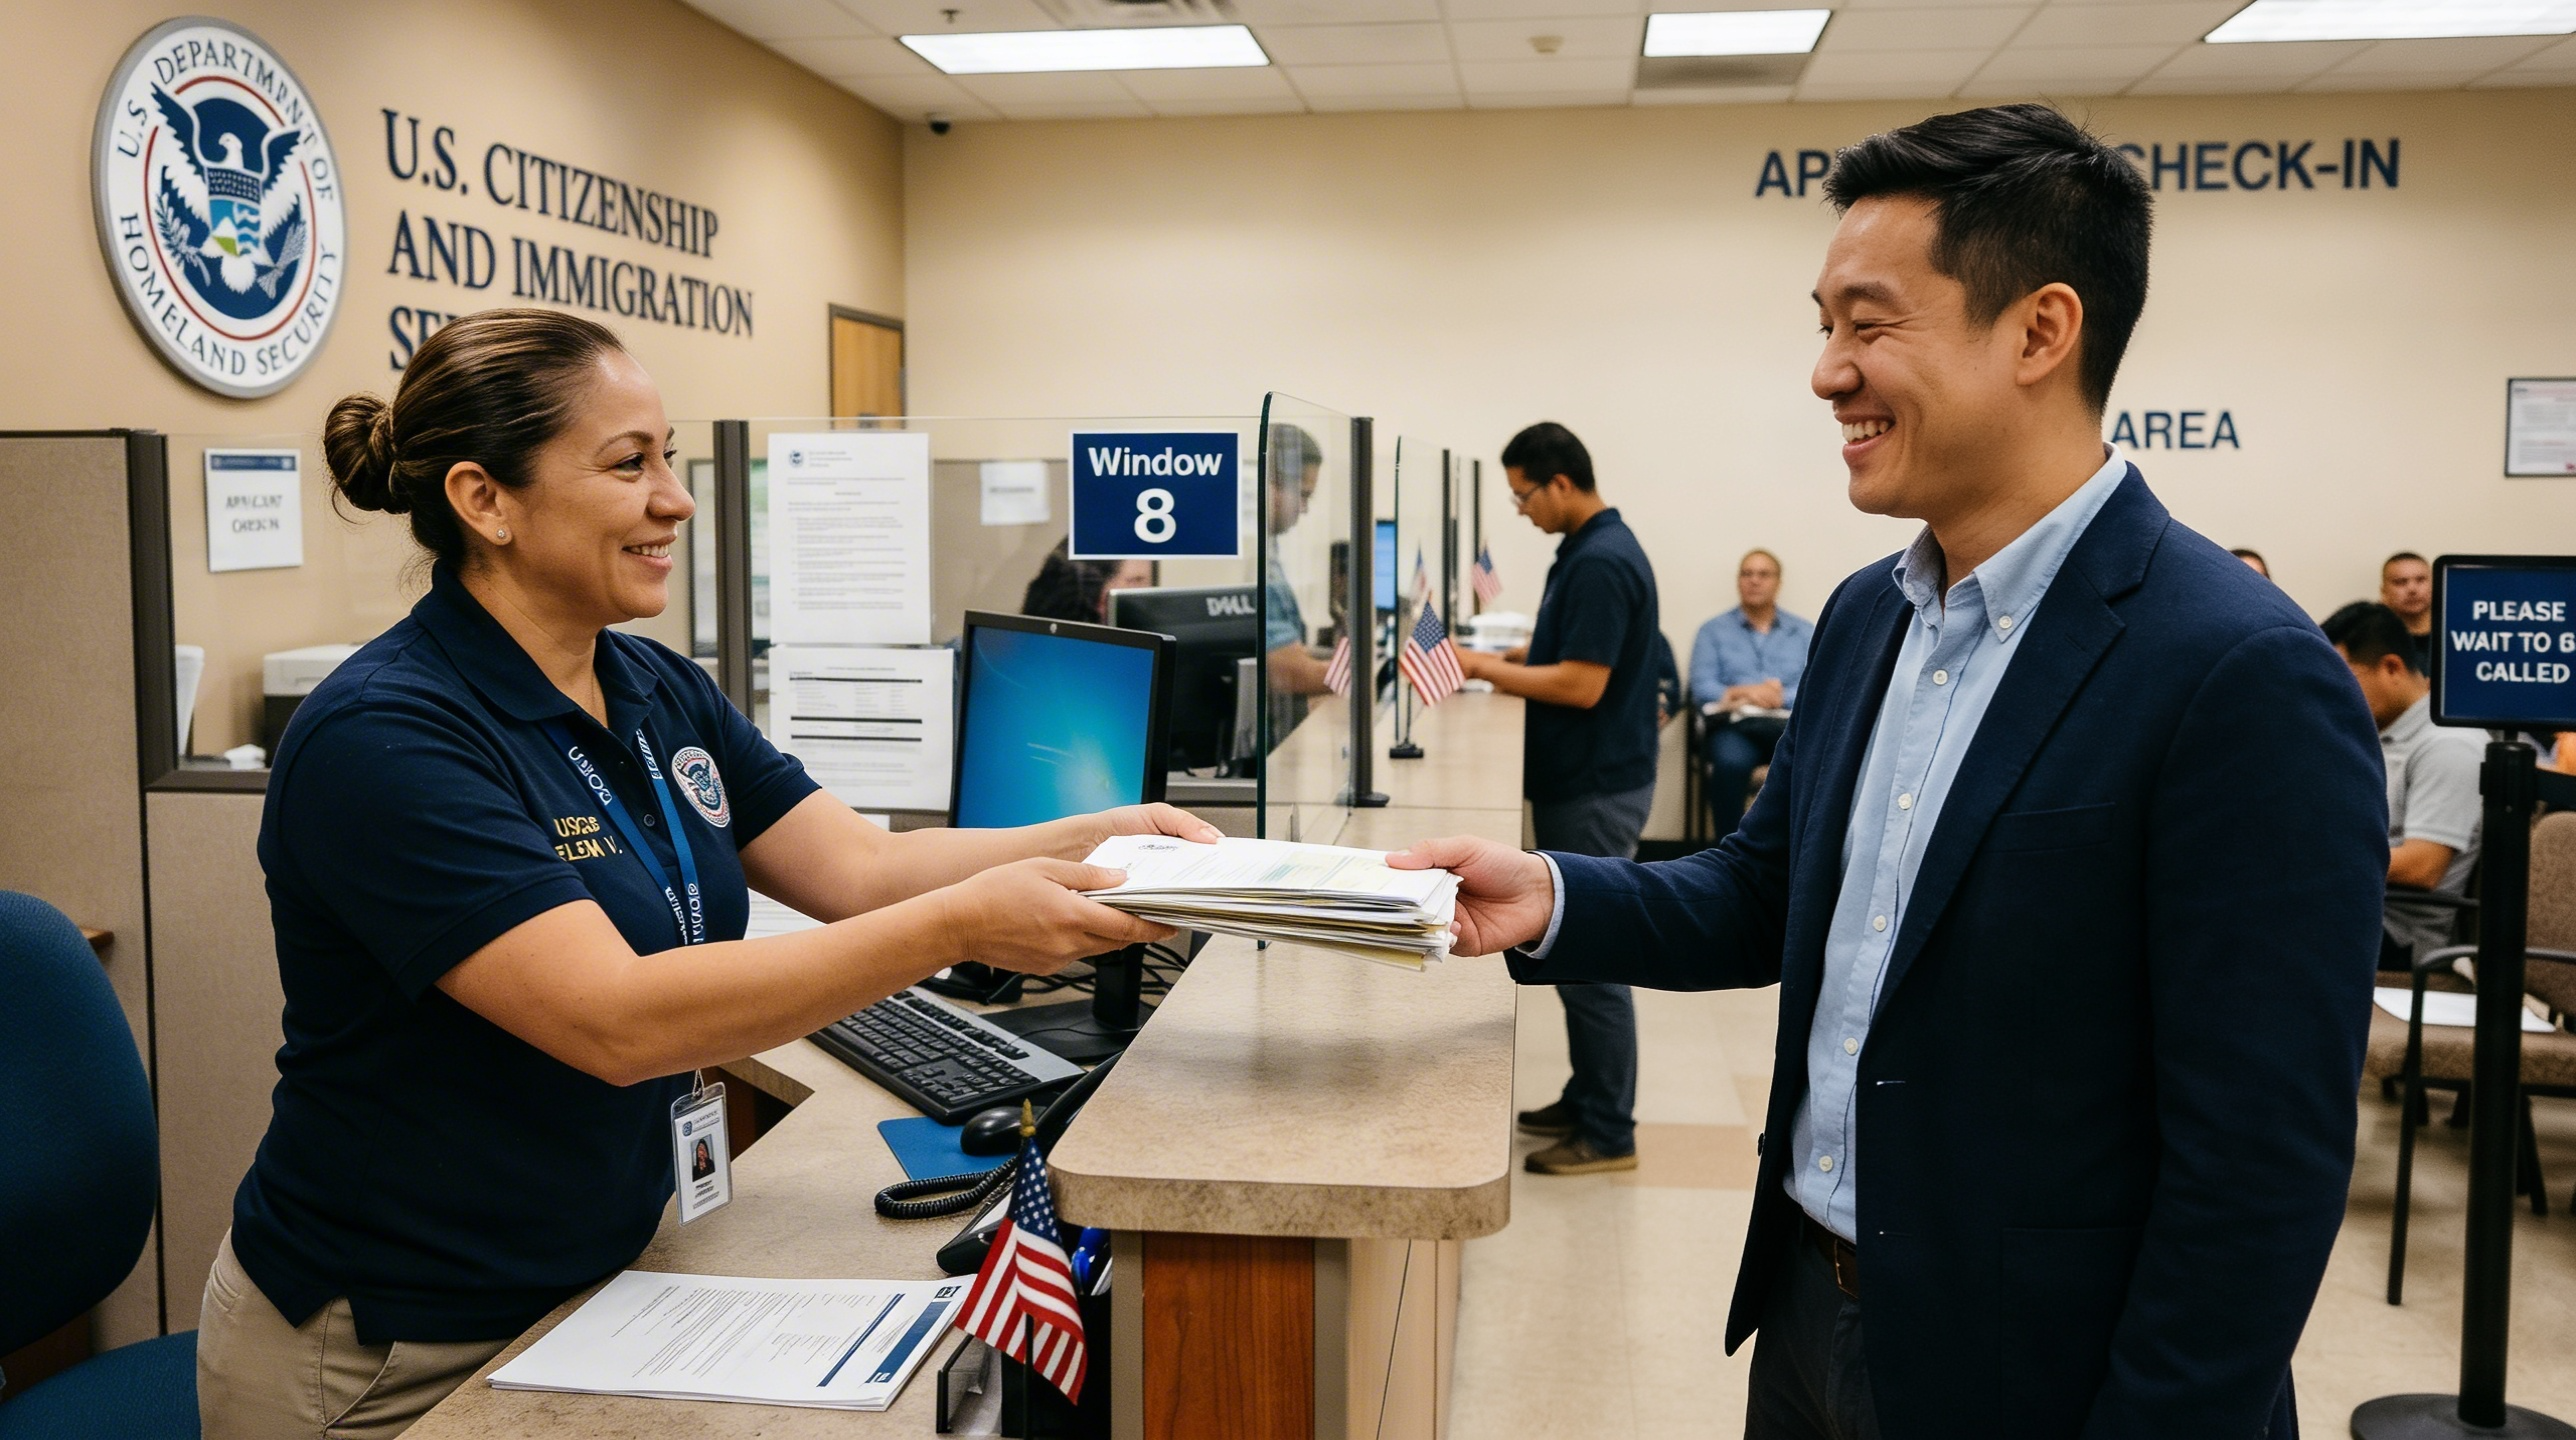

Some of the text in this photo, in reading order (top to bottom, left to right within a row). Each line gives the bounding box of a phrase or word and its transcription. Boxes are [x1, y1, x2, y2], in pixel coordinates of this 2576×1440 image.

[312, 158, 334, 201] OF
[381, 107, 718, 258] U.S. CITIZENSHIP
[388, 209, 753, 337] AND IMMIGRATION
[120, 213, 246, 376] HOMELAND
[256, 243, 336, 375] SECURITY
[2112, 411, 2240, 449] AREA
[1088, 447, 1223, 477] Window
[1133, 488, 1177, 544] 8
[2473, 601, 2566, 621] PLEASE
[2450, 630, 2514, 652] WAIT
[2518, 631, 2552, 653] TO
[2476, 661, 2571, 684] CALLED
